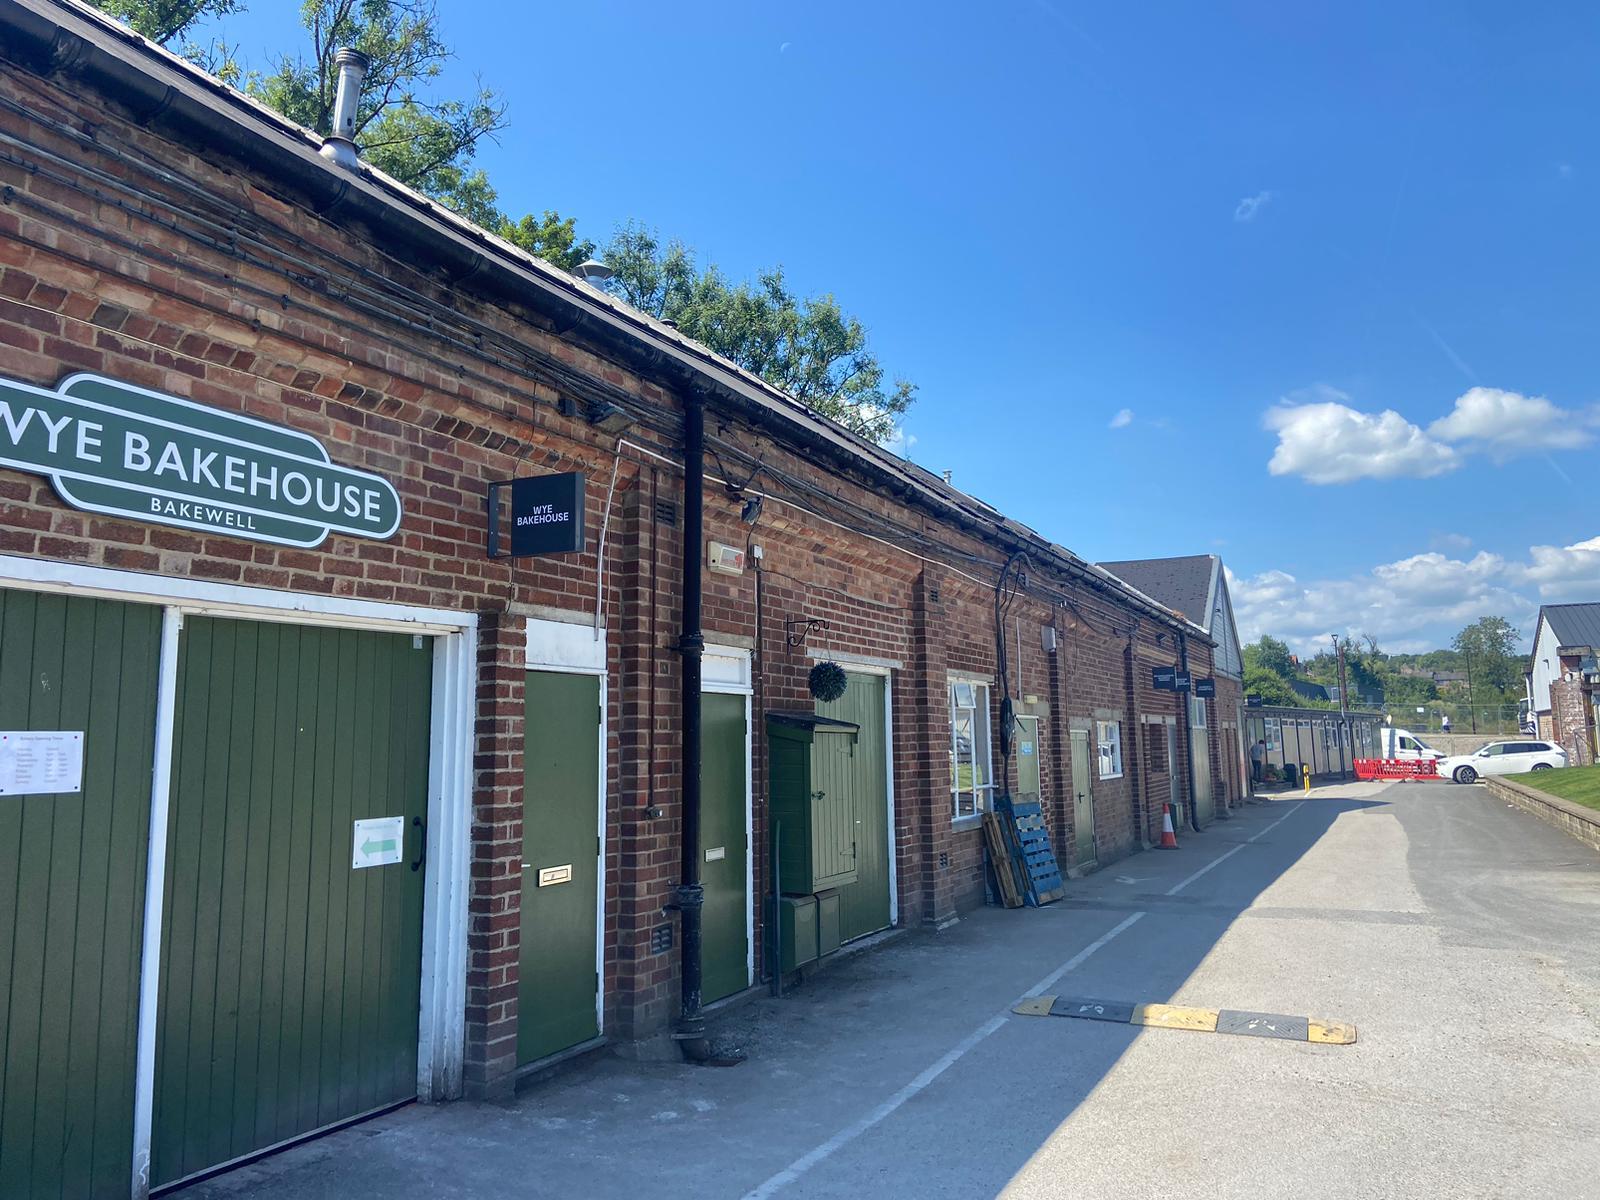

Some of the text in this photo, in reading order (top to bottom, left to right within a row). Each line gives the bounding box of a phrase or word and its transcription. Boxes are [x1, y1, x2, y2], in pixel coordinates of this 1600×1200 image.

[123, 431, 382, 523] BAKEHOUSE
[150, 497, 256, 530] BAKEWELL
[517, 512, 569, 526] BAKEHOUSE
[533, 504, 553, 515] WYE
